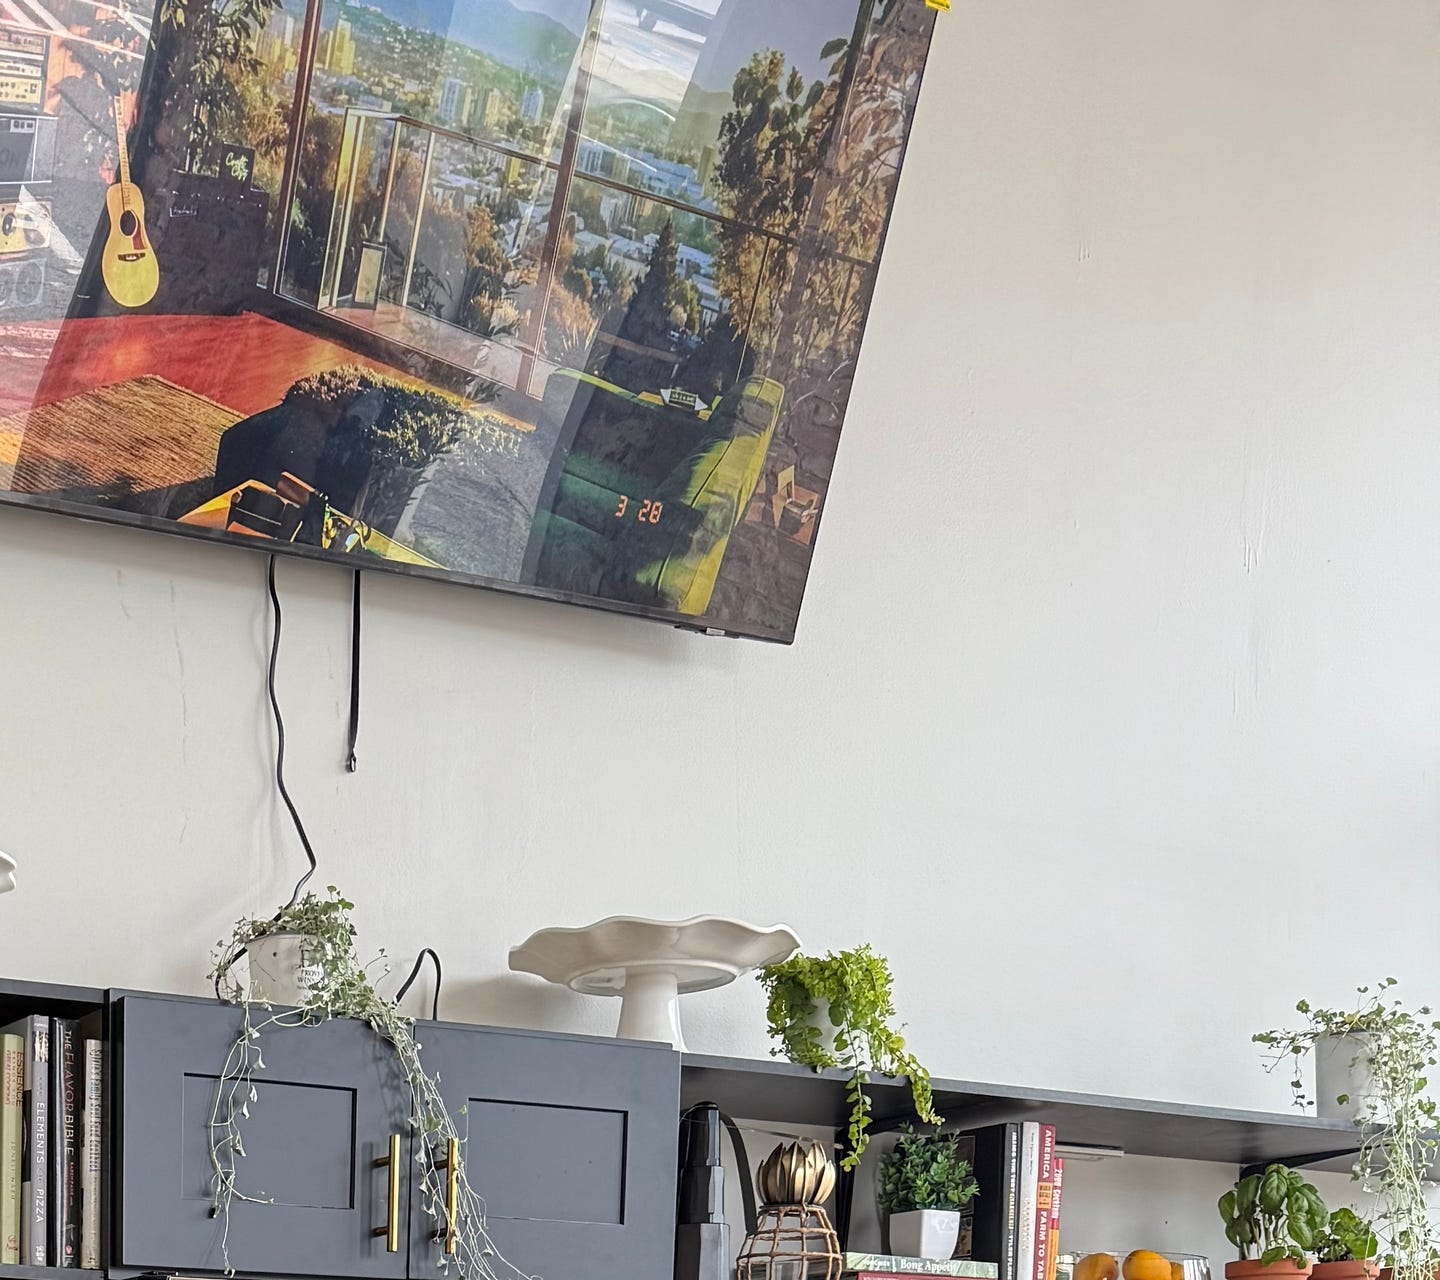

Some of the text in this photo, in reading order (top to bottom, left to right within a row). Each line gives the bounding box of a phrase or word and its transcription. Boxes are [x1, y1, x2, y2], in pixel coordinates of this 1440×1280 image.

[64, 1030, 72, 1050] THE
[16, 1051, 24, 1107] ESSENCE
[64, 1052, 74, 1112] FLAVOR
[36, 1102, 45, 1164] ELEMENTS
[64, 1114, 74, 1155] BIBLE
[1042, 1129, 1052, 1179] AMERICA
[35, 1188, 44, 1223] PIZZA
[1038, 1210, 1048, 1245] FARM
[900, 1258, 924, 1272] Bong
[1038, 1246, 1046, 1258] TO
